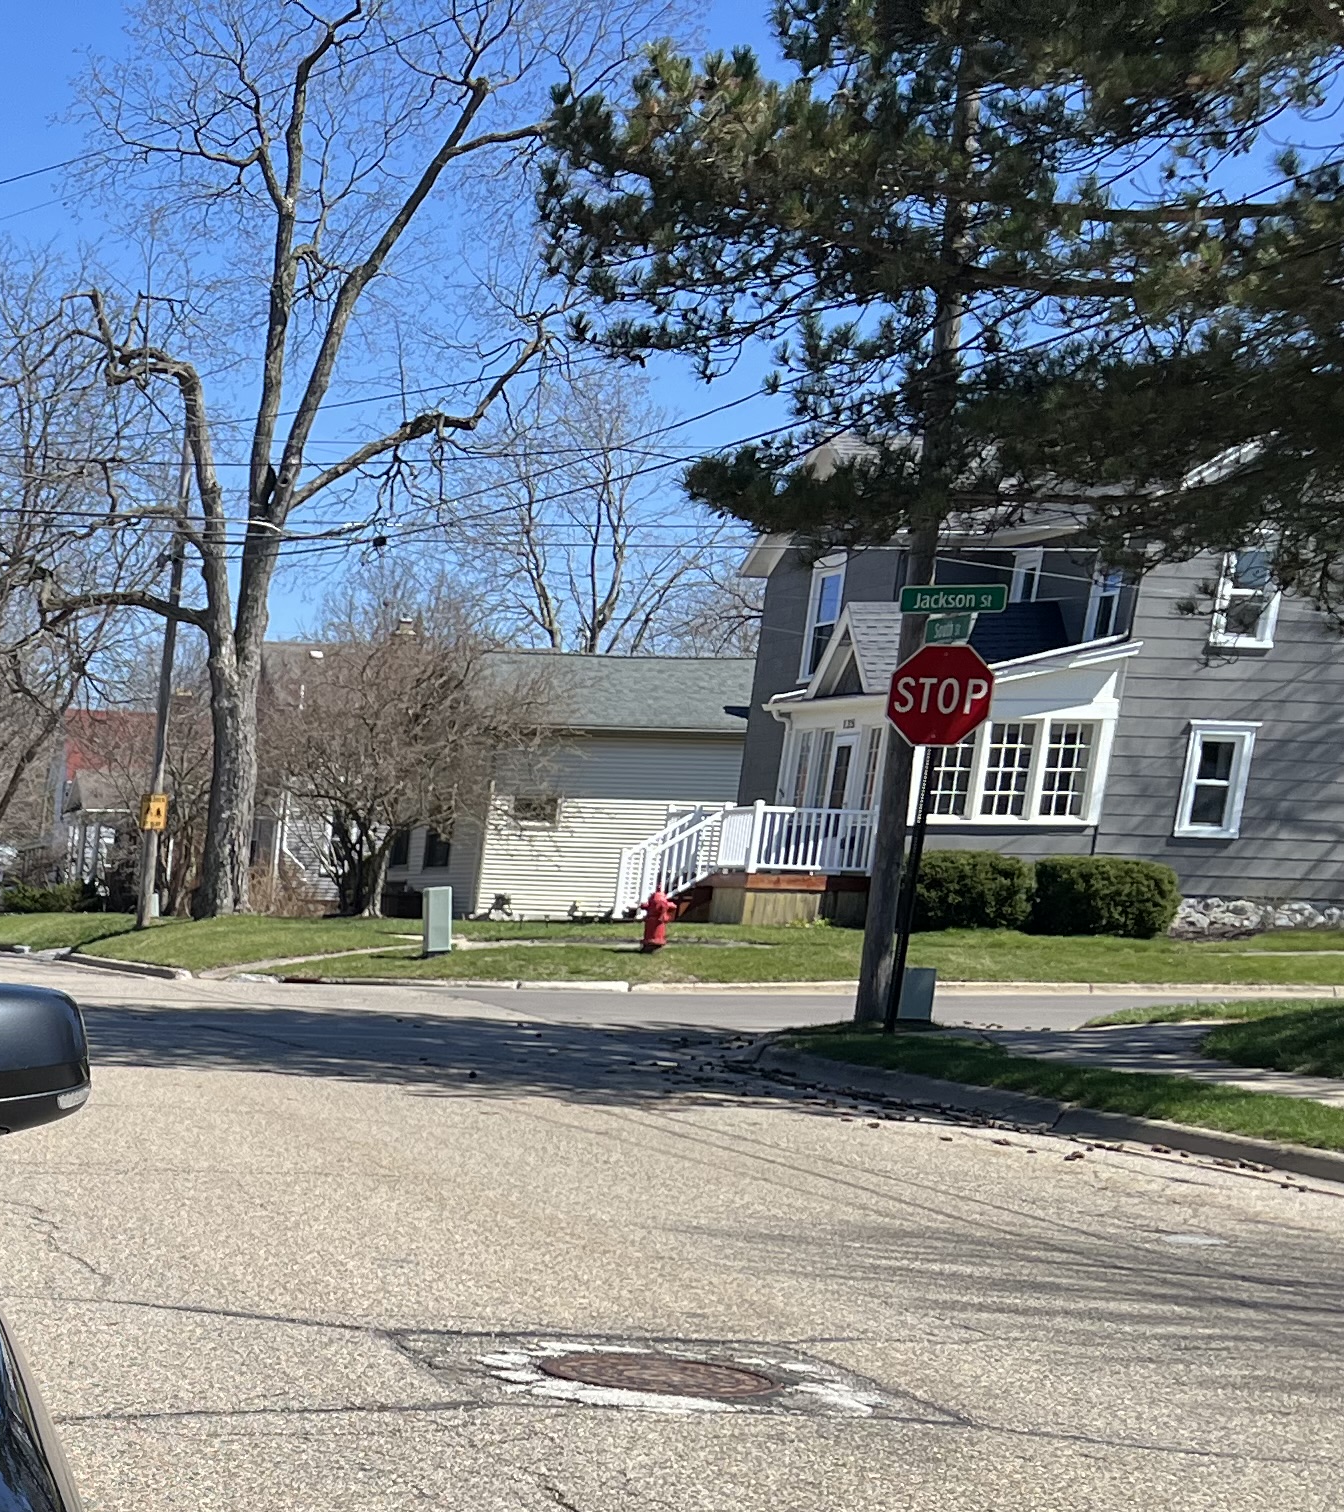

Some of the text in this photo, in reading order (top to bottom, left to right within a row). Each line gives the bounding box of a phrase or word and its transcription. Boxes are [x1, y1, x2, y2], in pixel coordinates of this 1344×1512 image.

[913, 592, 992, 609] Jackson St
[894, 676, 989, 715] STOP
